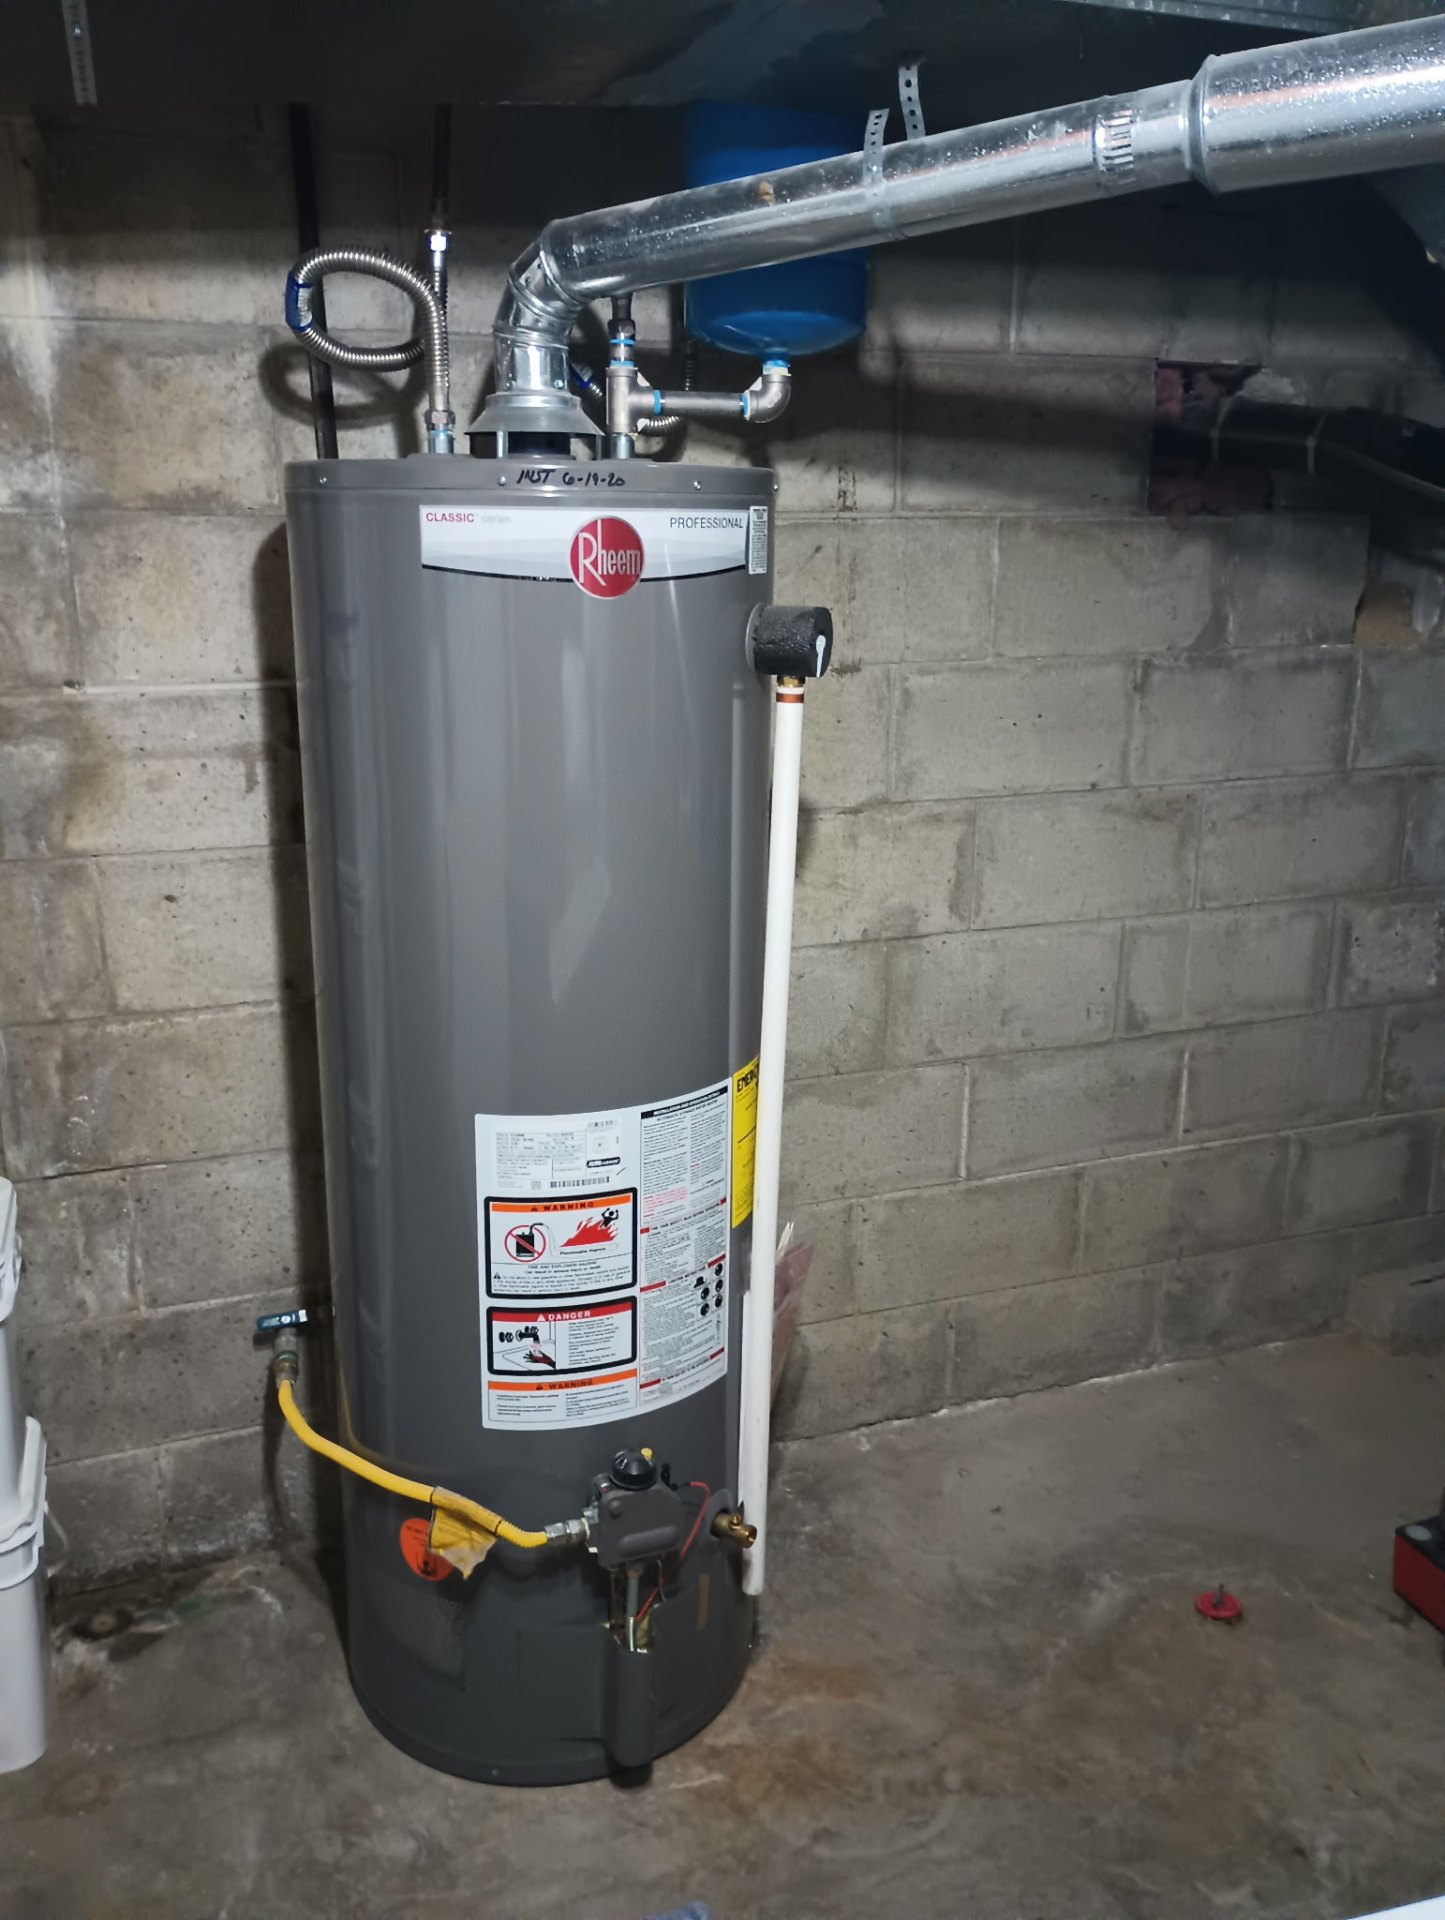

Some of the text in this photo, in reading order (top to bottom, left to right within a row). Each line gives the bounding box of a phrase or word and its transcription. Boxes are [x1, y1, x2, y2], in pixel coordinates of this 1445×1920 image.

[516, 468, 626, 487] INST 6-19-20
[426, 512, 475, 523] CLASSIC
[670, 516, 744, 529] PROFESSIONAL
[578, 519, 641, 587] Rheem
[544, 1201, 594, 1211] WARNING
[548, 1310, 591, 1321] DANGER
[548, 1379, 593, 1390] WARNING
